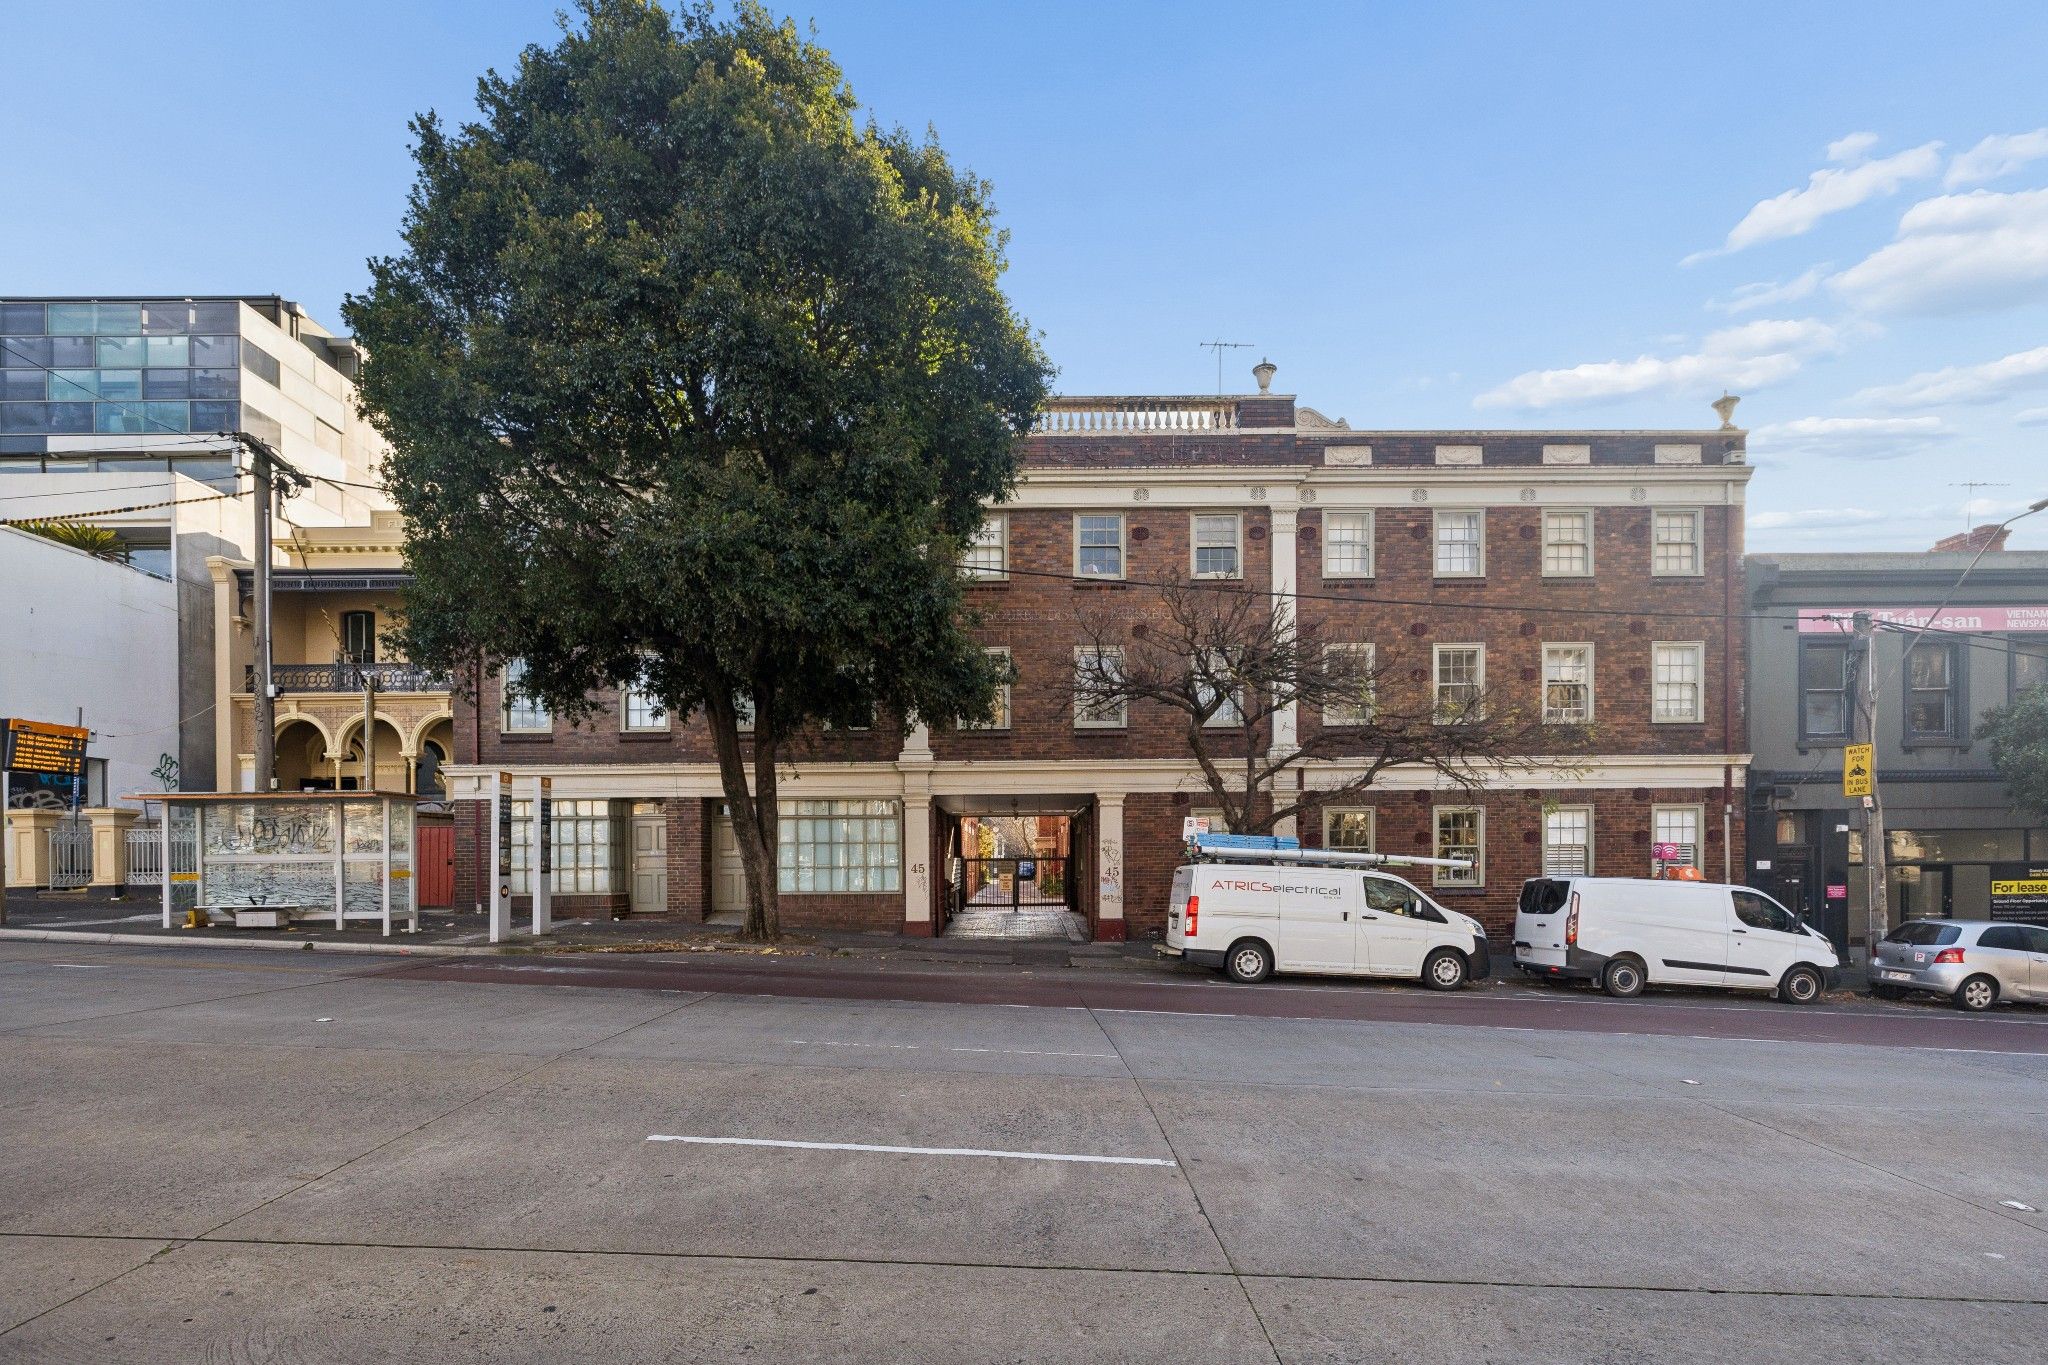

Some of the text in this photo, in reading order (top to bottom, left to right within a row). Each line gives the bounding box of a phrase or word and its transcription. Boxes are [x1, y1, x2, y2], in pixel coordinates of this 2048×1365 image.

[2007, 619, 2048, 628] NEWSPA
[1848, 747, 1870, 755] WATCH
[1856, 778, 1869, 786] BUS
[910, 863, 925, 874] 45
[1105, 867, 1120, 877] 45
[1994, 882, 2047, 893] For lease
